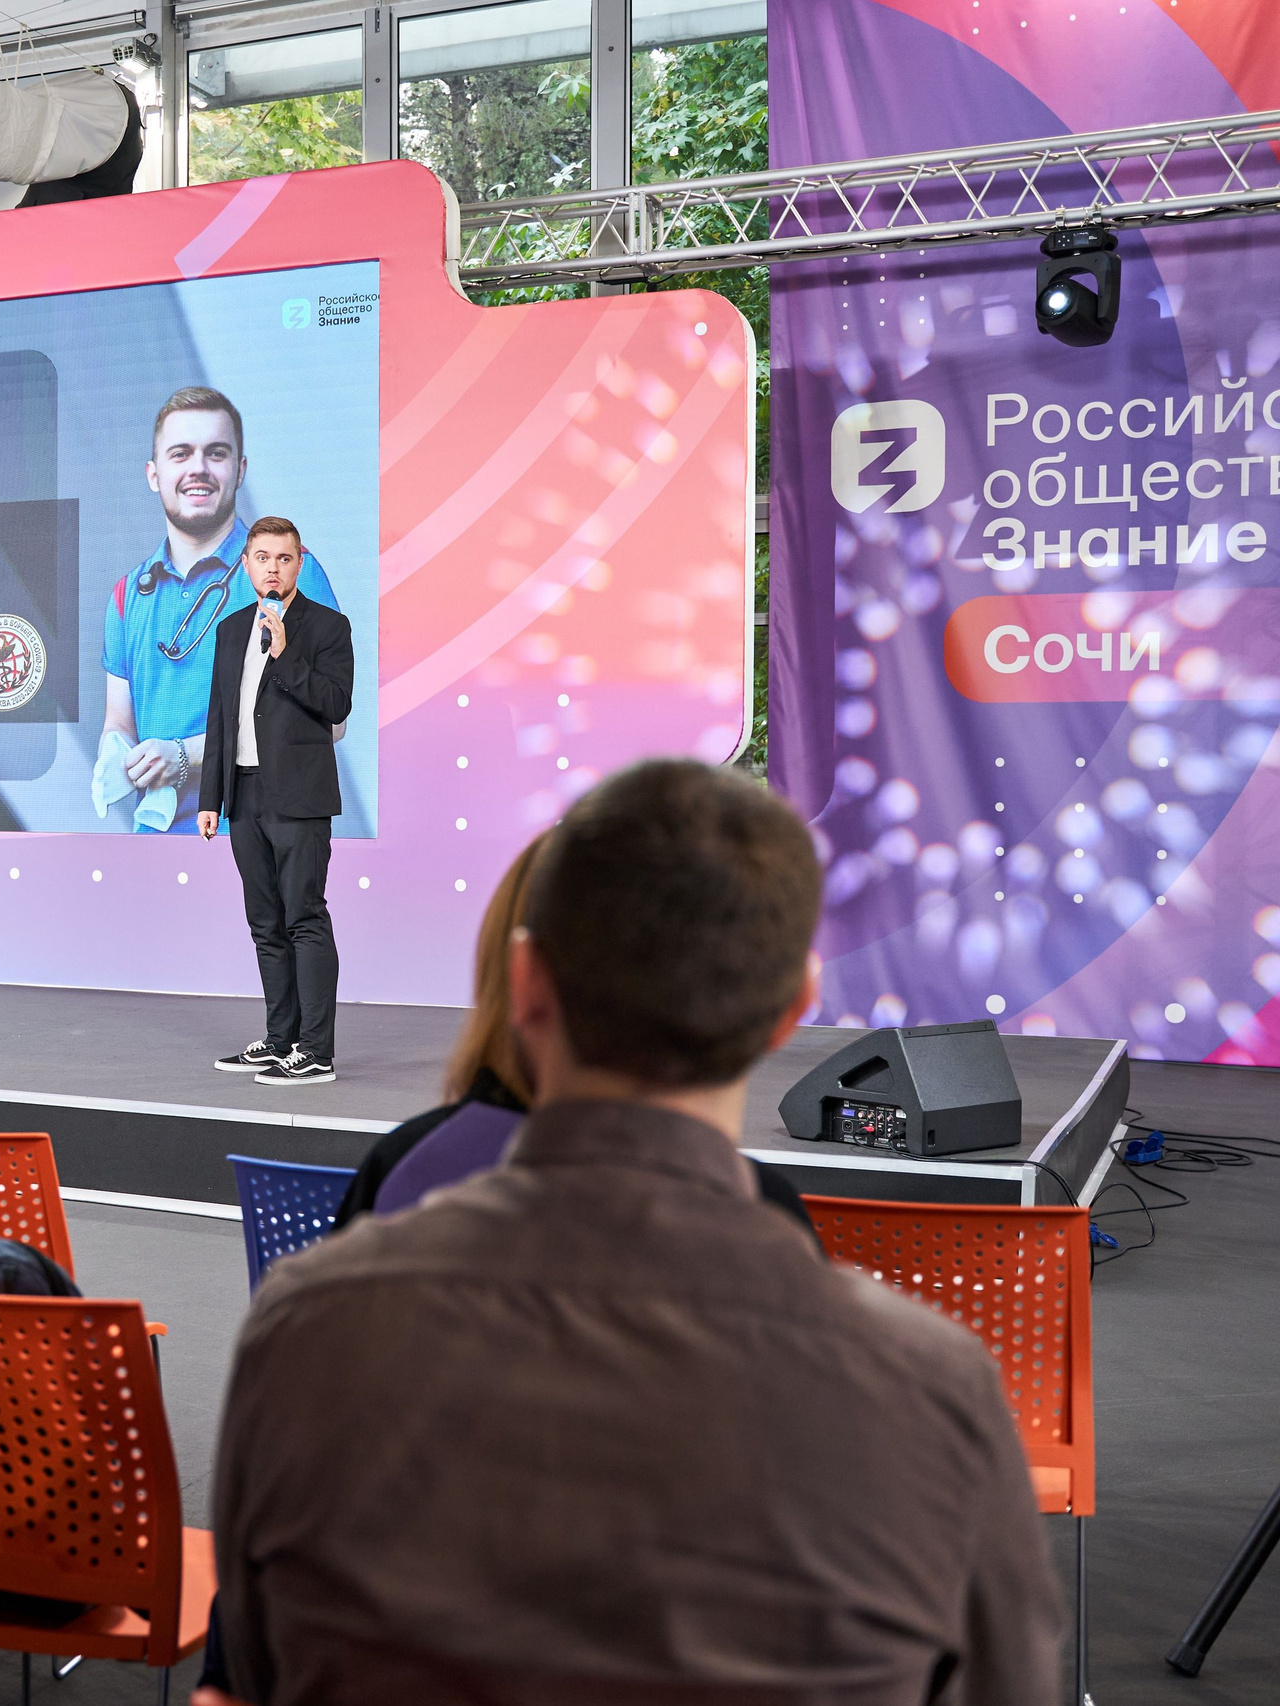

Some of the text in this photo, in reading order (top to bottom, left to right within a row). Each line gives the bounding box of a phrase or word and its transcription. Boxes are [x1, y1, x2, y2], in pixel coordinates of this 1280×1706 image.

[318, 293, 380, 306] Российско
[318, 304, 373, 316] общество
[318, 316, 360, 327] Знание
[981, 517, 1267, 571] Знание
[983, 624, 1161, 674] Сочи
